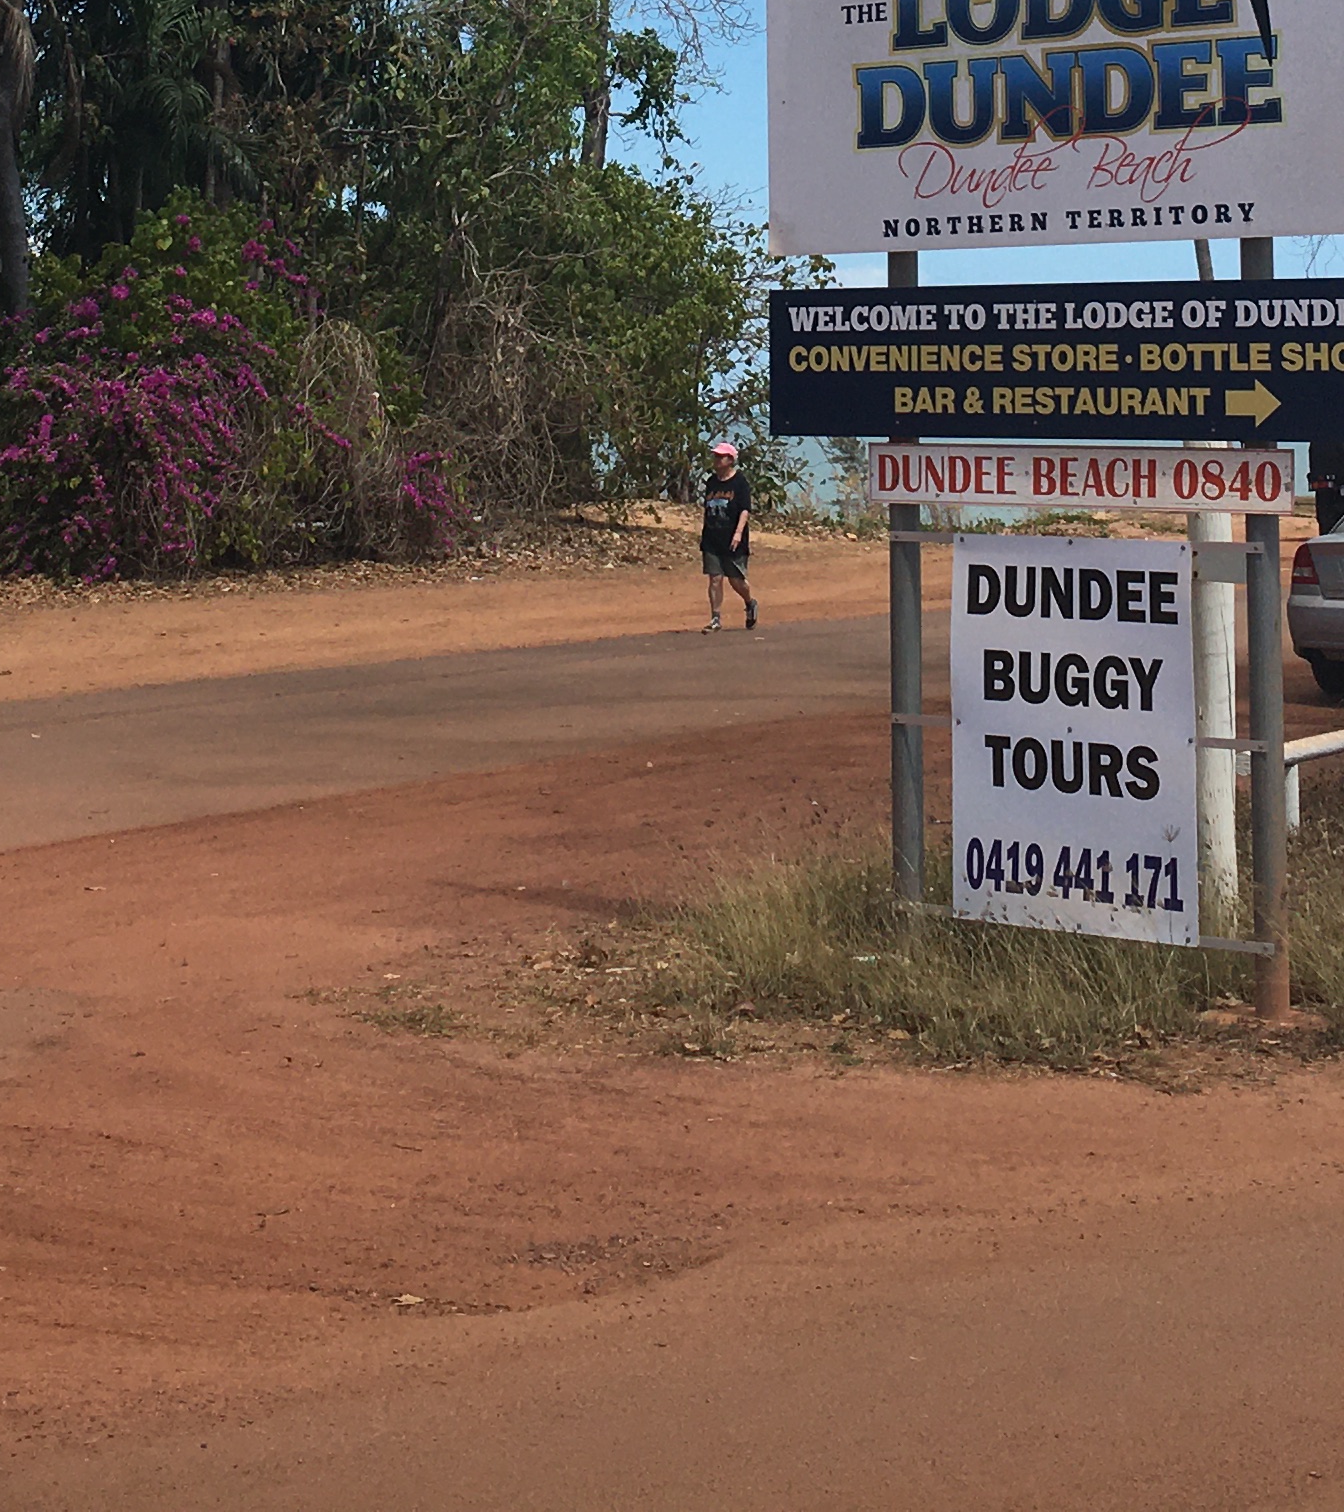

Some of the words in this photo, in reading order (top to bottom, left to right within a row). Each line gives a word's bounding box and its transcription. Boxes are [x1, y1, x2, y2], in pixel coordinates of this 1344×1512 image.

[841, 2, 888, 25] THE
[855, 34, 1283, 150] DUNDEE
[898, 105, 1086, 209] Dundee
[1072, 97, 1252, 204] Beach
[883, 212, 1049, 238] NORTHERN
[1066, 202, 1256, 230] TERRITORY
[788, 304, 937, 332] WELCOME
[944, 303, 986, 330] TO
[993, 302, 1057, 330] THE
[1064, 300, 1174, 329] LODGE
[1181, 300, 1227, 328] OF
[788, 344, 1004, 372] CONVENIENCE
[1011, 343, 1120, 372] STORE
[1139, 342, 1272, 371] BOTTLE
[894, 386, 956, 414] BAR
[962, 386, 985, 414] &
[992, 386, 1211, 416] RESTAURANT
[877, 453, 1017, 495] DUNDEE
[1032, 457, 1157, 499] BEACH
[1172, 458, 1282, 502] 0840
[966, 563, 1179, 625] DUNDEE
[982, 649, 1163, 712] BUGGY
[984, 734, 1160, 801] TOURS
[966, 837, 1044, 897] 0419
[1053, 846, 1114, 904] 441
[1125, 853, 1184, 912] 171
